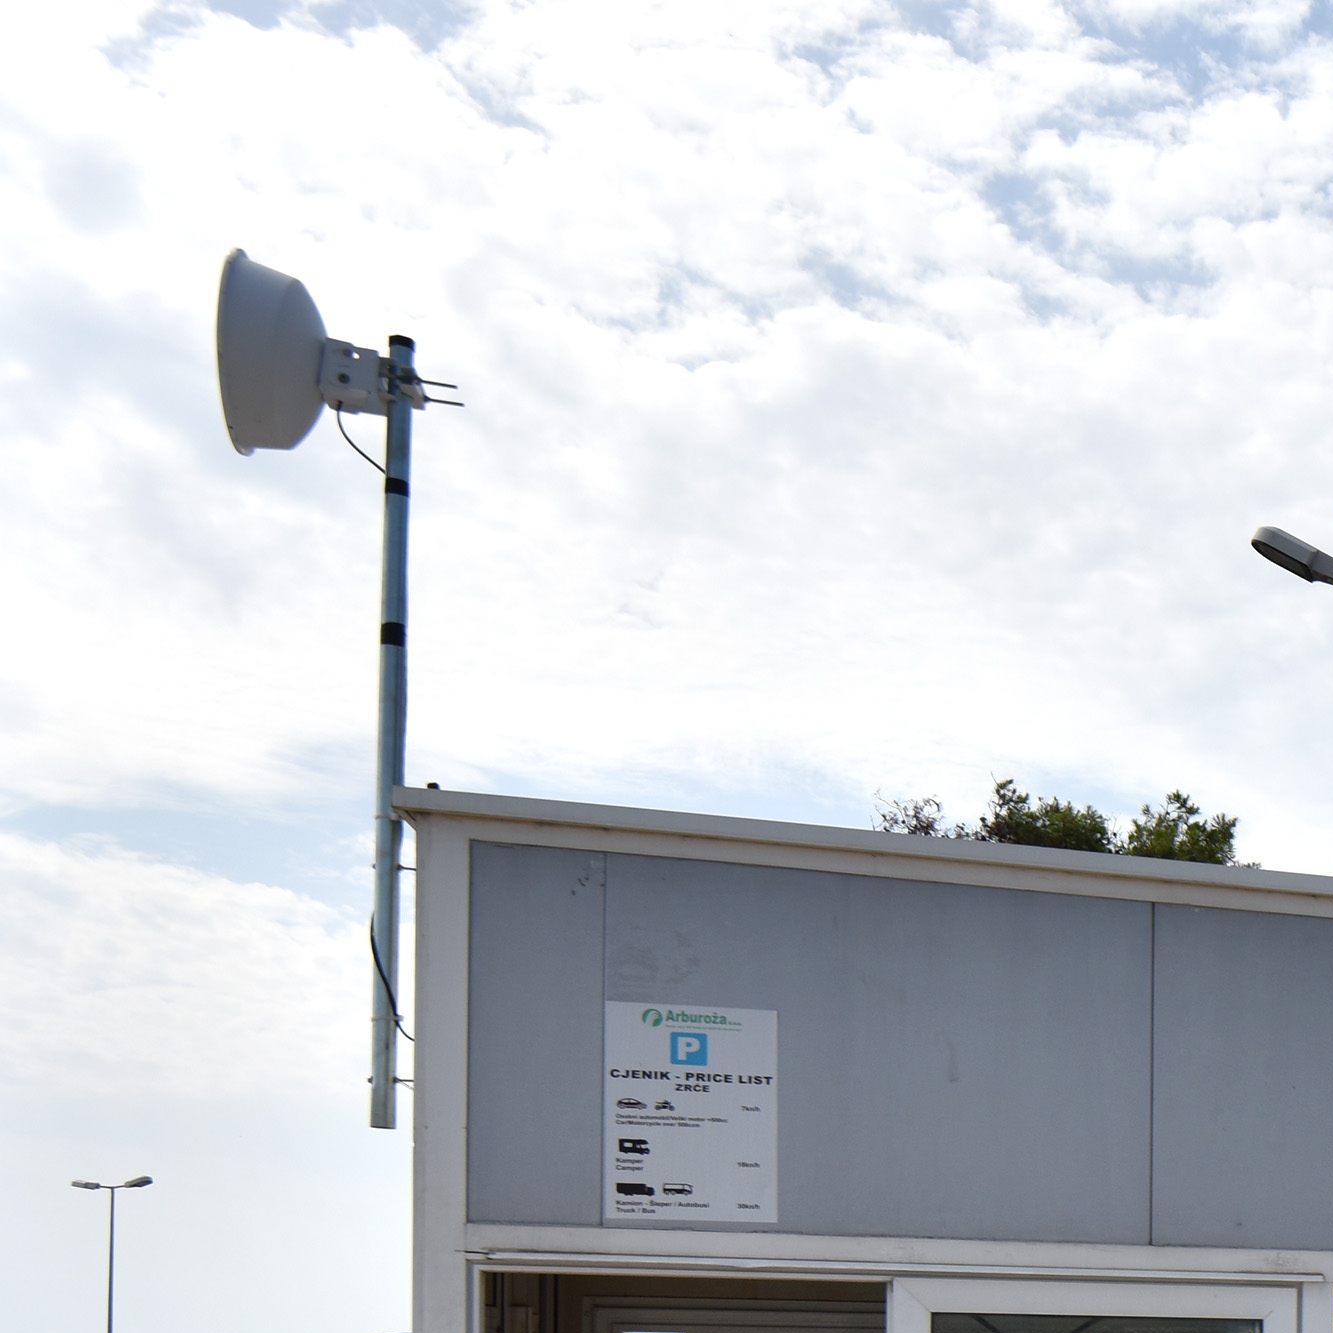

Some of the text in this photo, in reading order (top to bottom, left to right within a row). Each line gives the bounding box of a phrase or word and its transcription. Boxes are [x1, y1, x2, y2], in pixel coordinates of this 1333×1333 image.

[666, 1010, 727, 1024] Arburoža
[678, 1036, 700, 1060] P
[610, 1069, 671, 1081] CJENIK
[685, 1072, 733, 1083] PRICE
[738, 1075, 773, 1085] LIST
